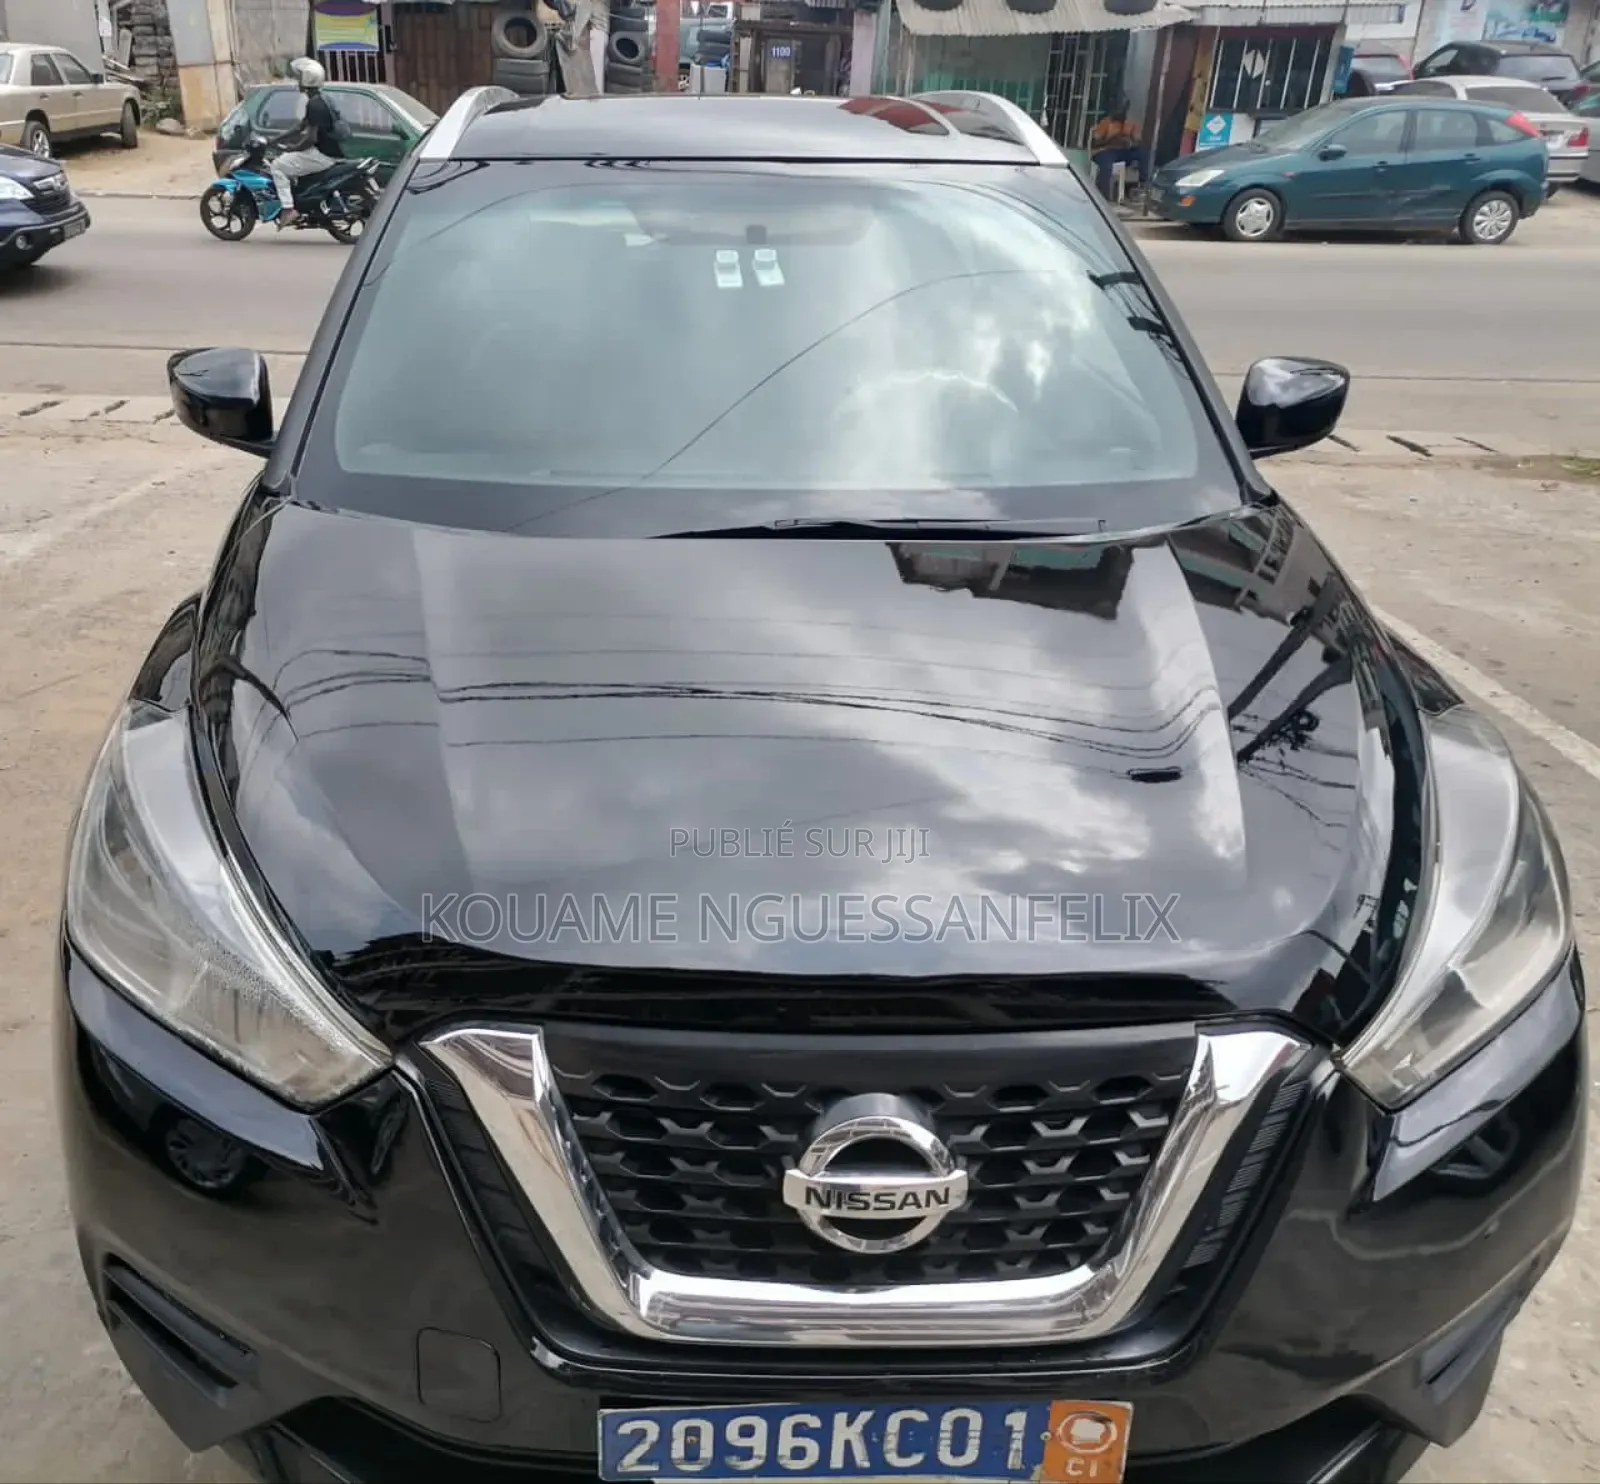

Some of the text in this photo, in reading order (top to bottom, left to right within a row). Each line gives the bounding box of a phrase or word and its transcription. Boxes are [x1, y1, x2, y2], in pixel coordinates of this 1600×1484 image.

[805, 1187, 950, 1211] NISSAN
[616, 1408, 1028, 1472] 2096KC01
[1064, 1457, 1098, 1478] CI
